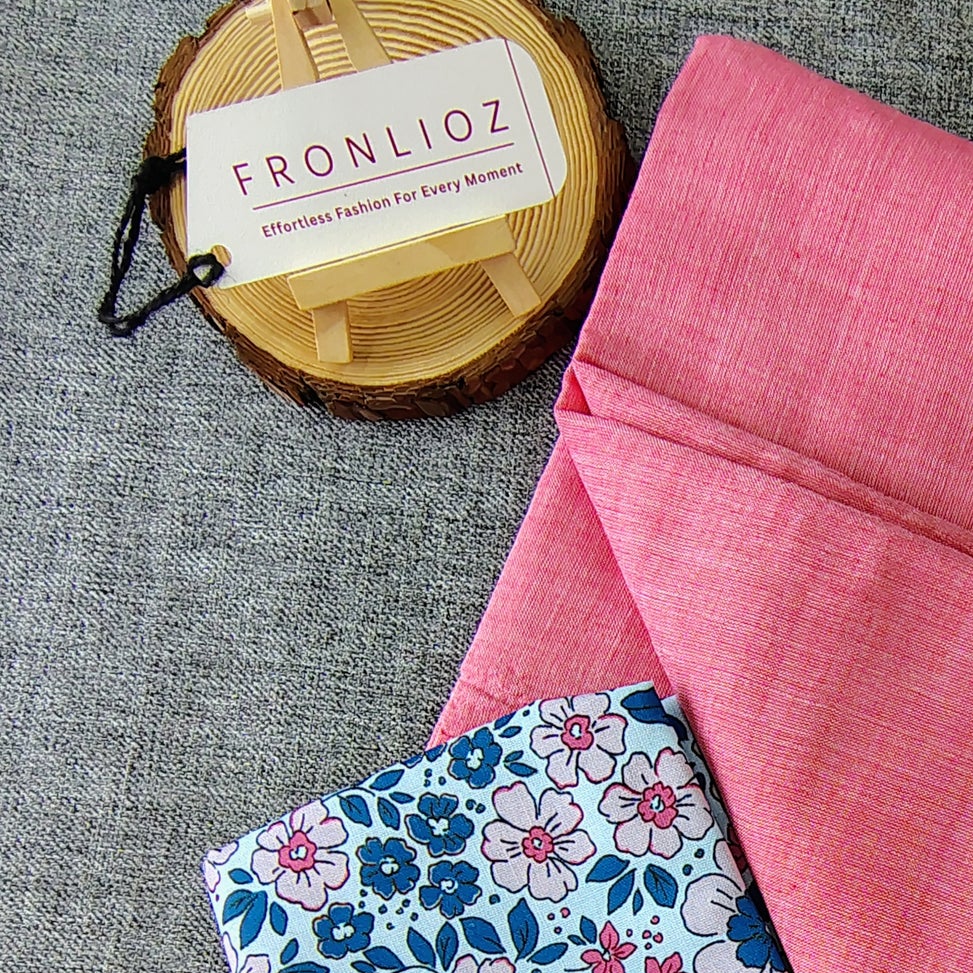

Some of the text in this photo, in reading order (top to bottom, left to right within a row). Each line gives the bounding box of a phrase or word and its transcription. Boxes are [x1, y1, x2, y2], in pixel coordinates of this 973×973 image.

[232, 100, 509, 196] FRONLIOZ
[261, 162, 524, 238] Effortless Fashion For Every Moment
